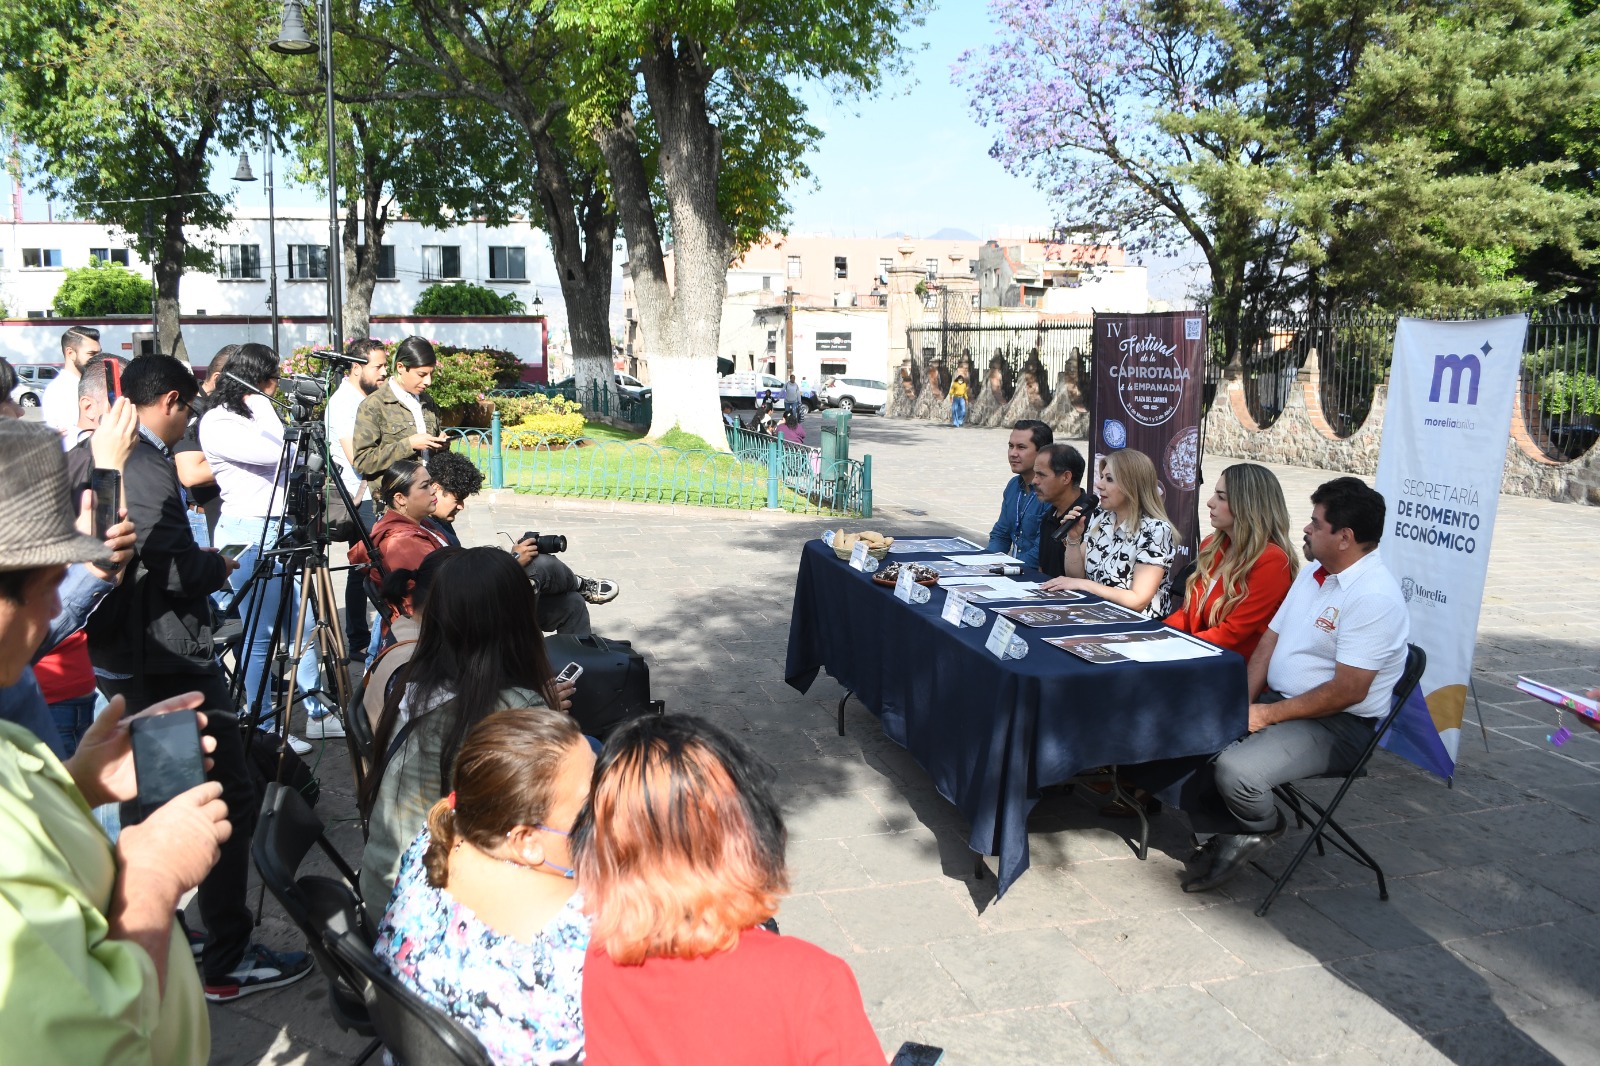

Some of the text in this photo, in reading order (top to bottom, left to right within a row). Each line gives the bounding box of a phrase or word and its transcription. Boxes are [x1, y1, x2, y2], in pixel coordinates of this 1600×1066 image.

[1106, 322, 1123, 338] IV
[1119, 332, 1178, 356] Festival
[1140, 353, 1156, 362] de la
[1109, 365, 1191, 380] CAPIROTADA
[1134, 383, 1180, 392] EMPANADA
[1402, 478, 1479, 507] SECRETARÍA
[1397, 499, 1480, 531] DE FOMENTO
[1395, 521, 1476, 554] ECONÓMICO
[1177, 544, 1188, 556] PM
[1416, 584, 1446, 603] Morelia
